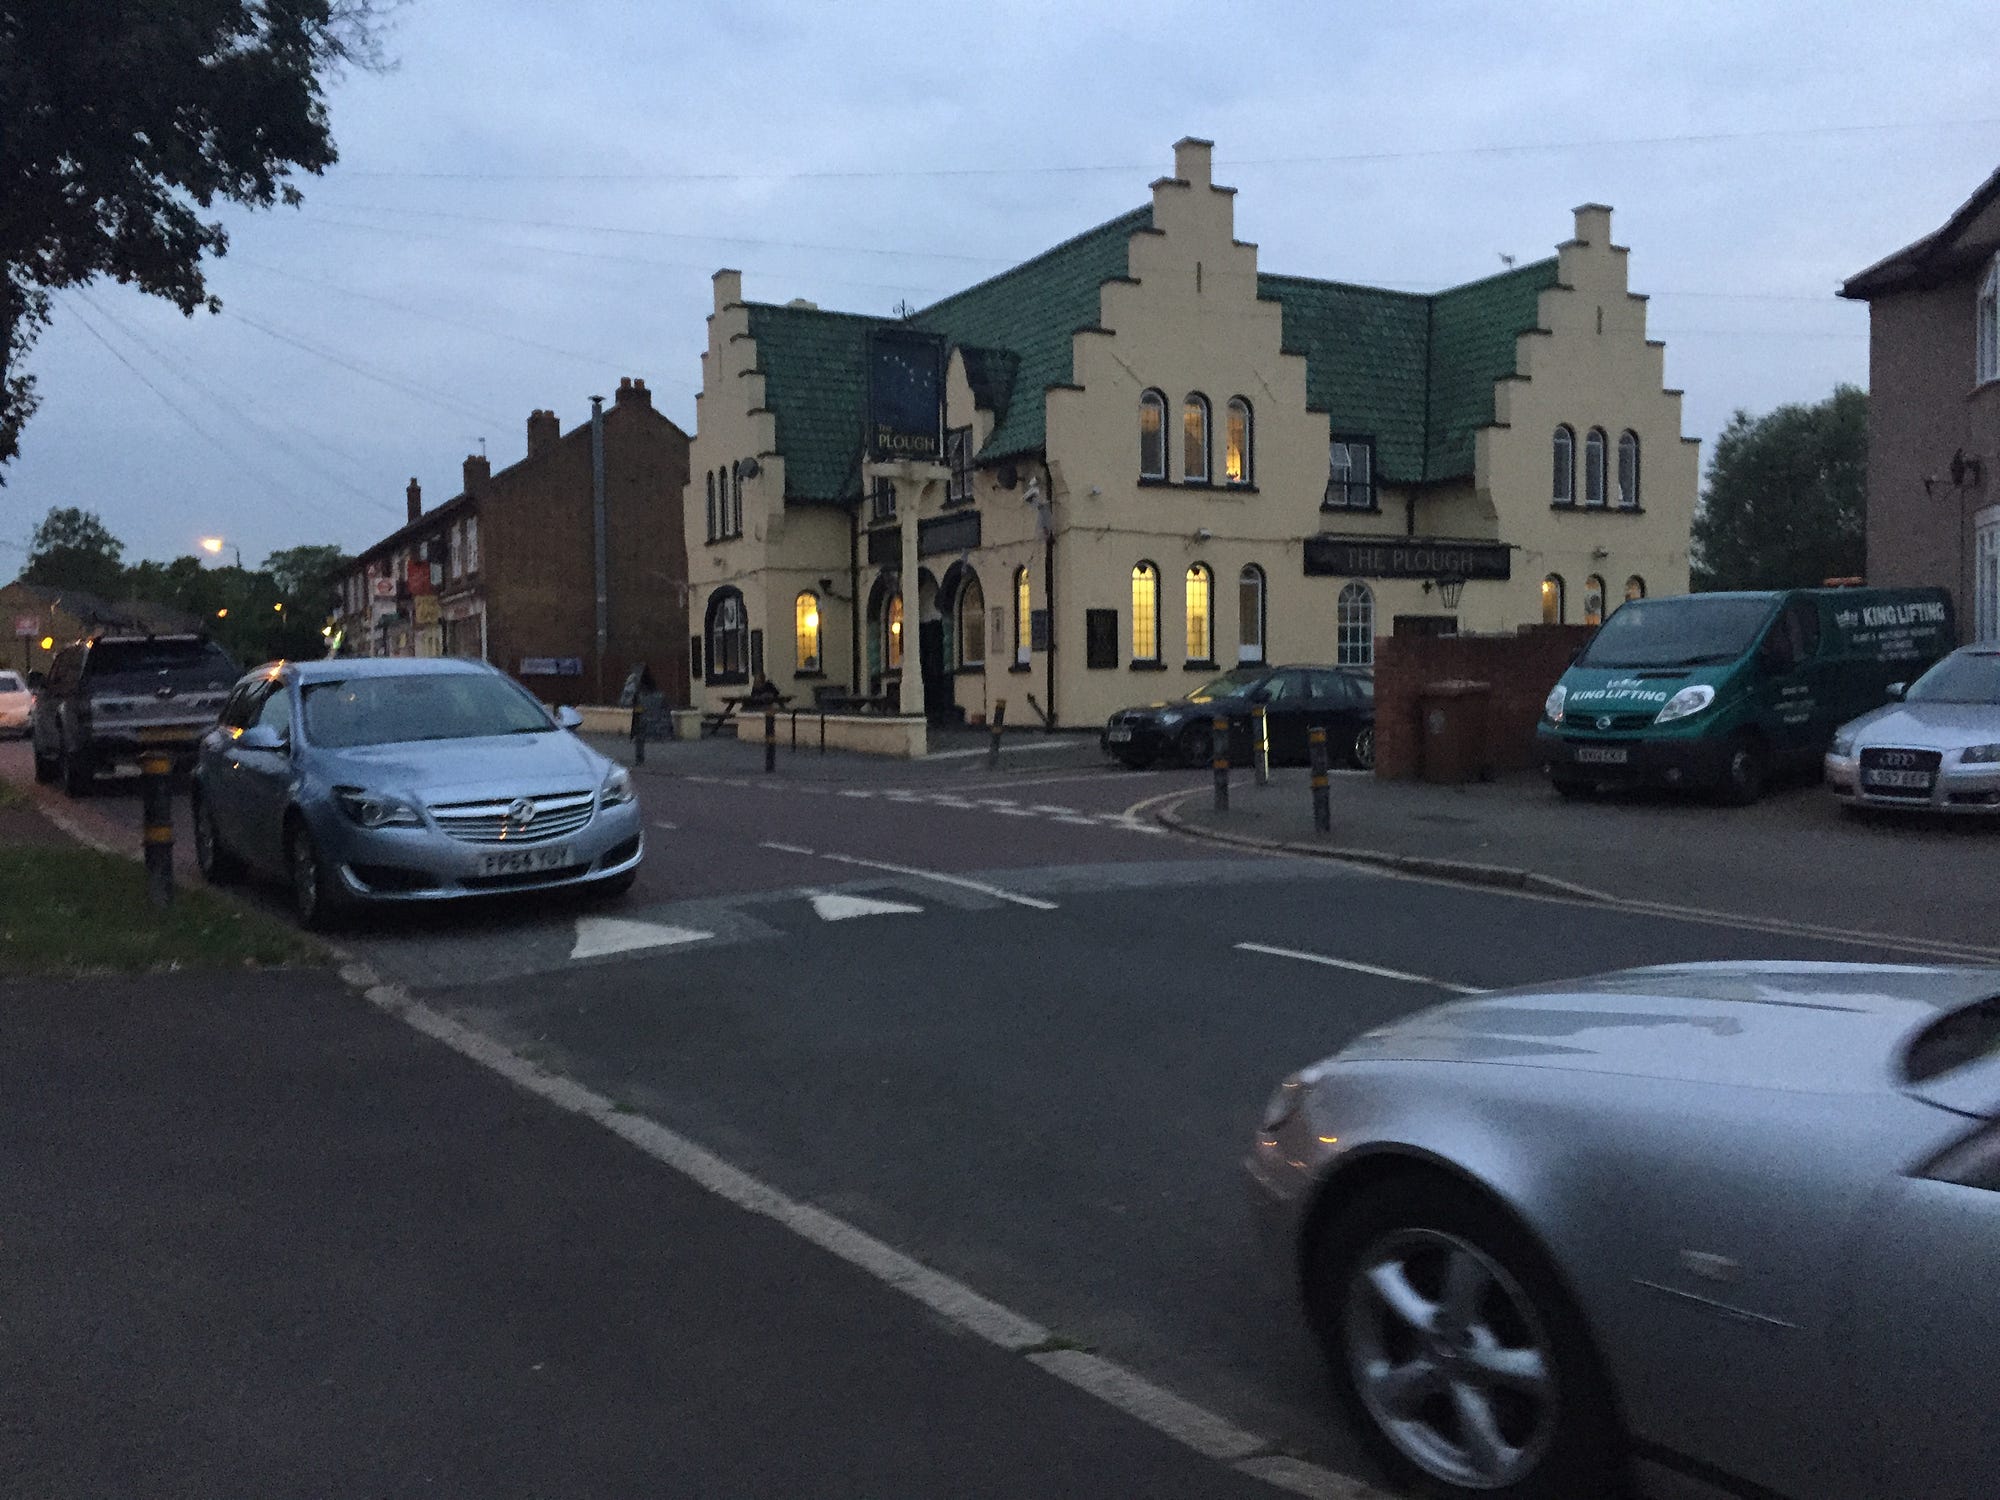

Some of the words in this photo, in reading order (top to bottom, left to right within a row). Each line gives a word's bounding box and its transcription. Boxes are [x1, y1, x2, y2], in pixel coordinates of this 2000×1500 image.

[878, 434, 935, 451] PLOUGH
[1347, 548, 1386, 569] THE
[1393, 549, 1473, 573] PLOUGH
[1862, 605, 1896, 626] KING
[1896, 602, 1945, 624] LIFTING
[1570, 689, 1606, 701] KING
[1606, 689, 1667, 702] LIFTING
